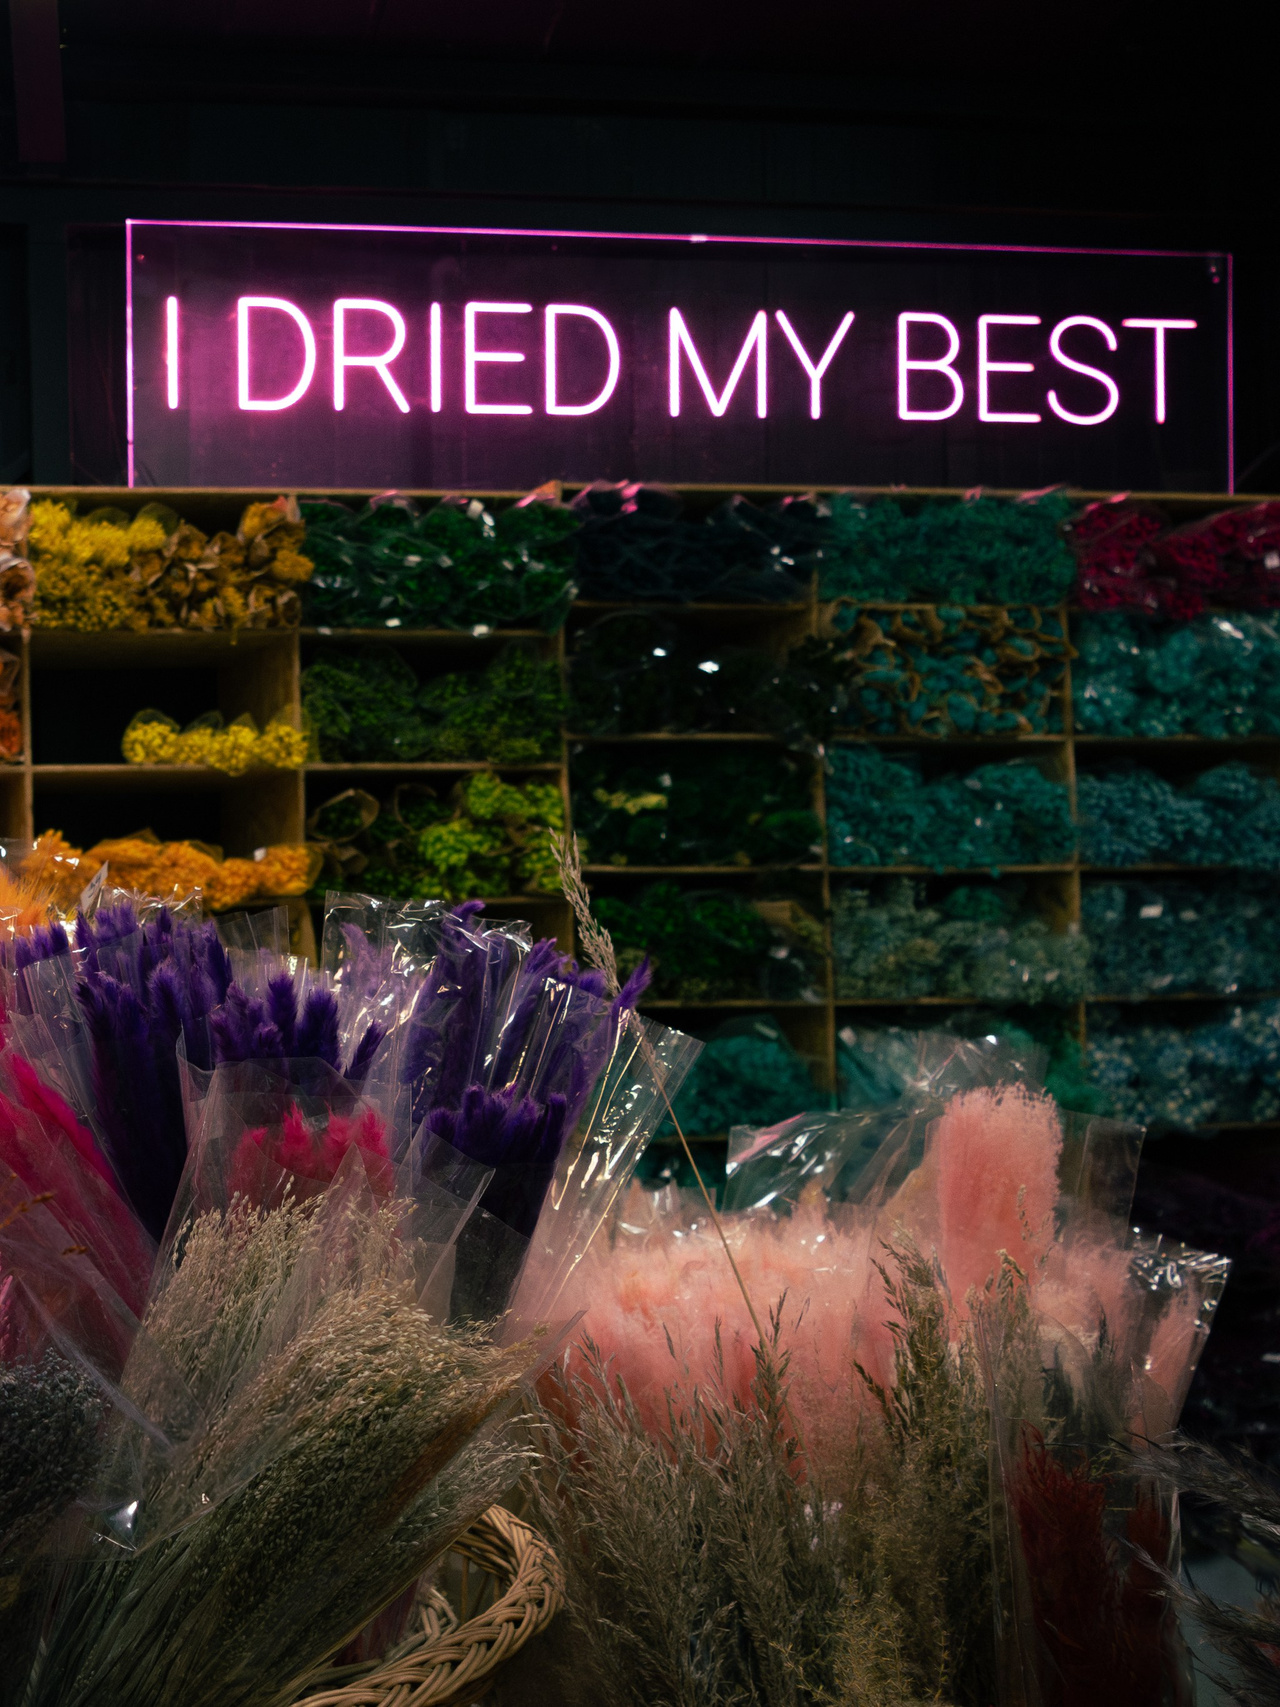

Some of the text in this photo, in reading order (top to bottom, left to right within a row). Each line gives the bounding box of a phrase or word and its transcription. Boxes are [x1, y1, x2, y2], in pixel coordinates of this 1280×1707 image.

[165, 296, 1198, 425] I DRIED MY BEST
